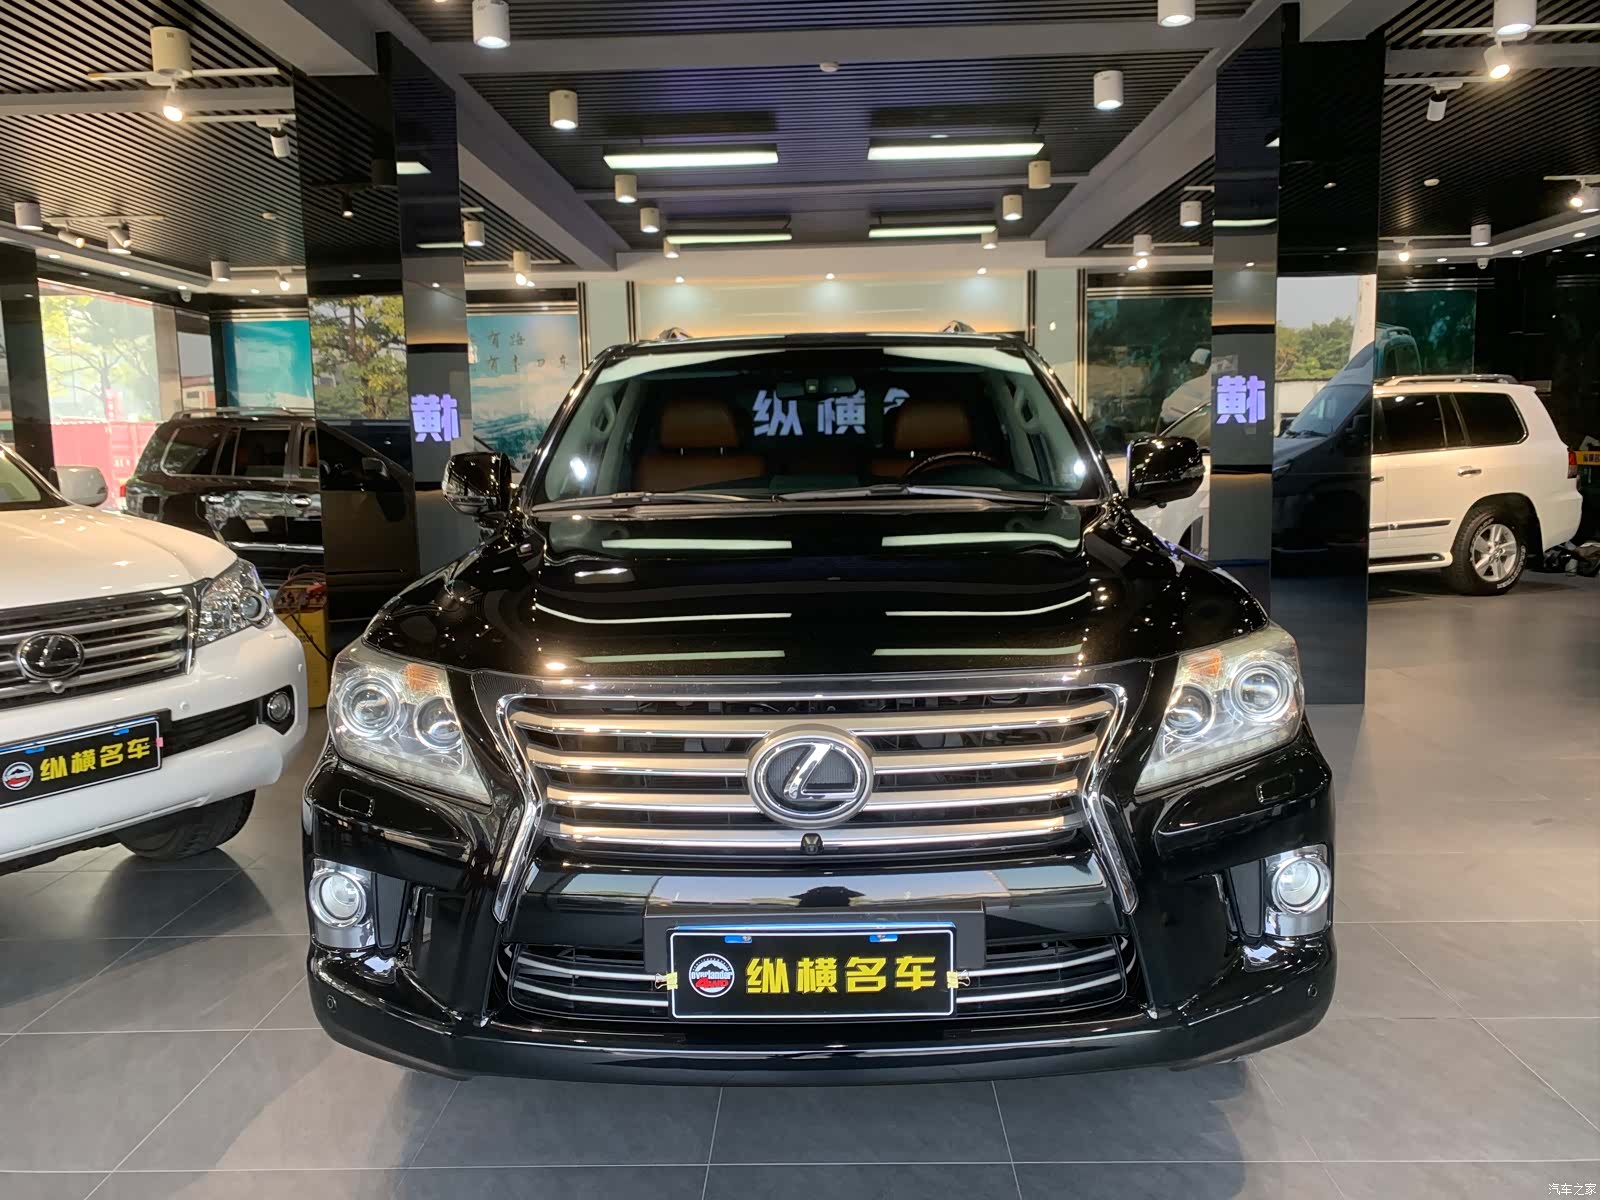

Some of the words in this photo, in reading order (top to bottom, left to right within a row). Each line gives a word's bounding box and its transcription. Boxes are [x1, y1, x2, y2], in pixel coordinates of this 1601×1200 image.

[39, 736, 150, 782] 纵横名车
[746, 955, 937, 994] 纵横名车
